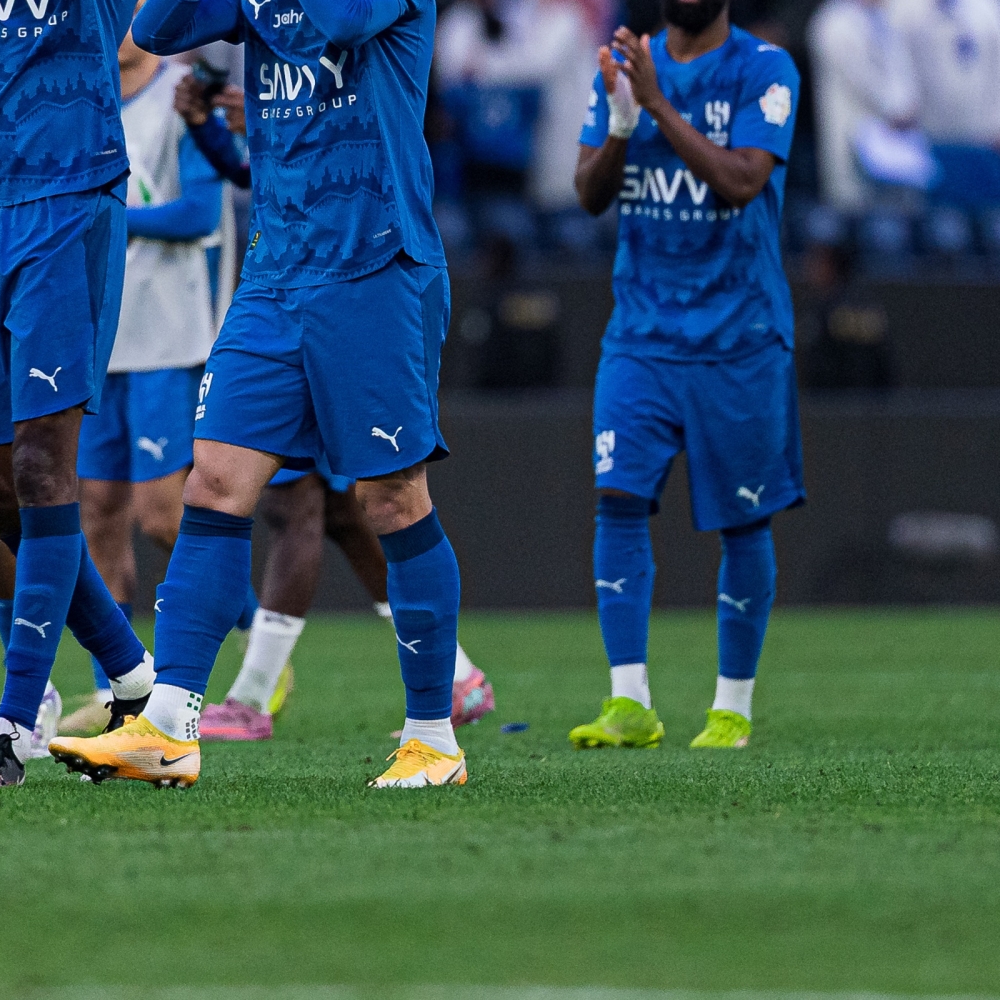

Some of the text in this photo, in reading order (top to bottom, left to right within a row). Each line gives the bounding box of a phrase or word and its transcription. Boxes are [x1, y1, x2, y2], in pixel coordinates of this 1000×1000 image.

[17, 10, 68, 38] GRUP
[272, 9, 305, 28] Jah
[261, 94, 357, 119] GES GROUP
[618, 164, 709, 206] SAVV
